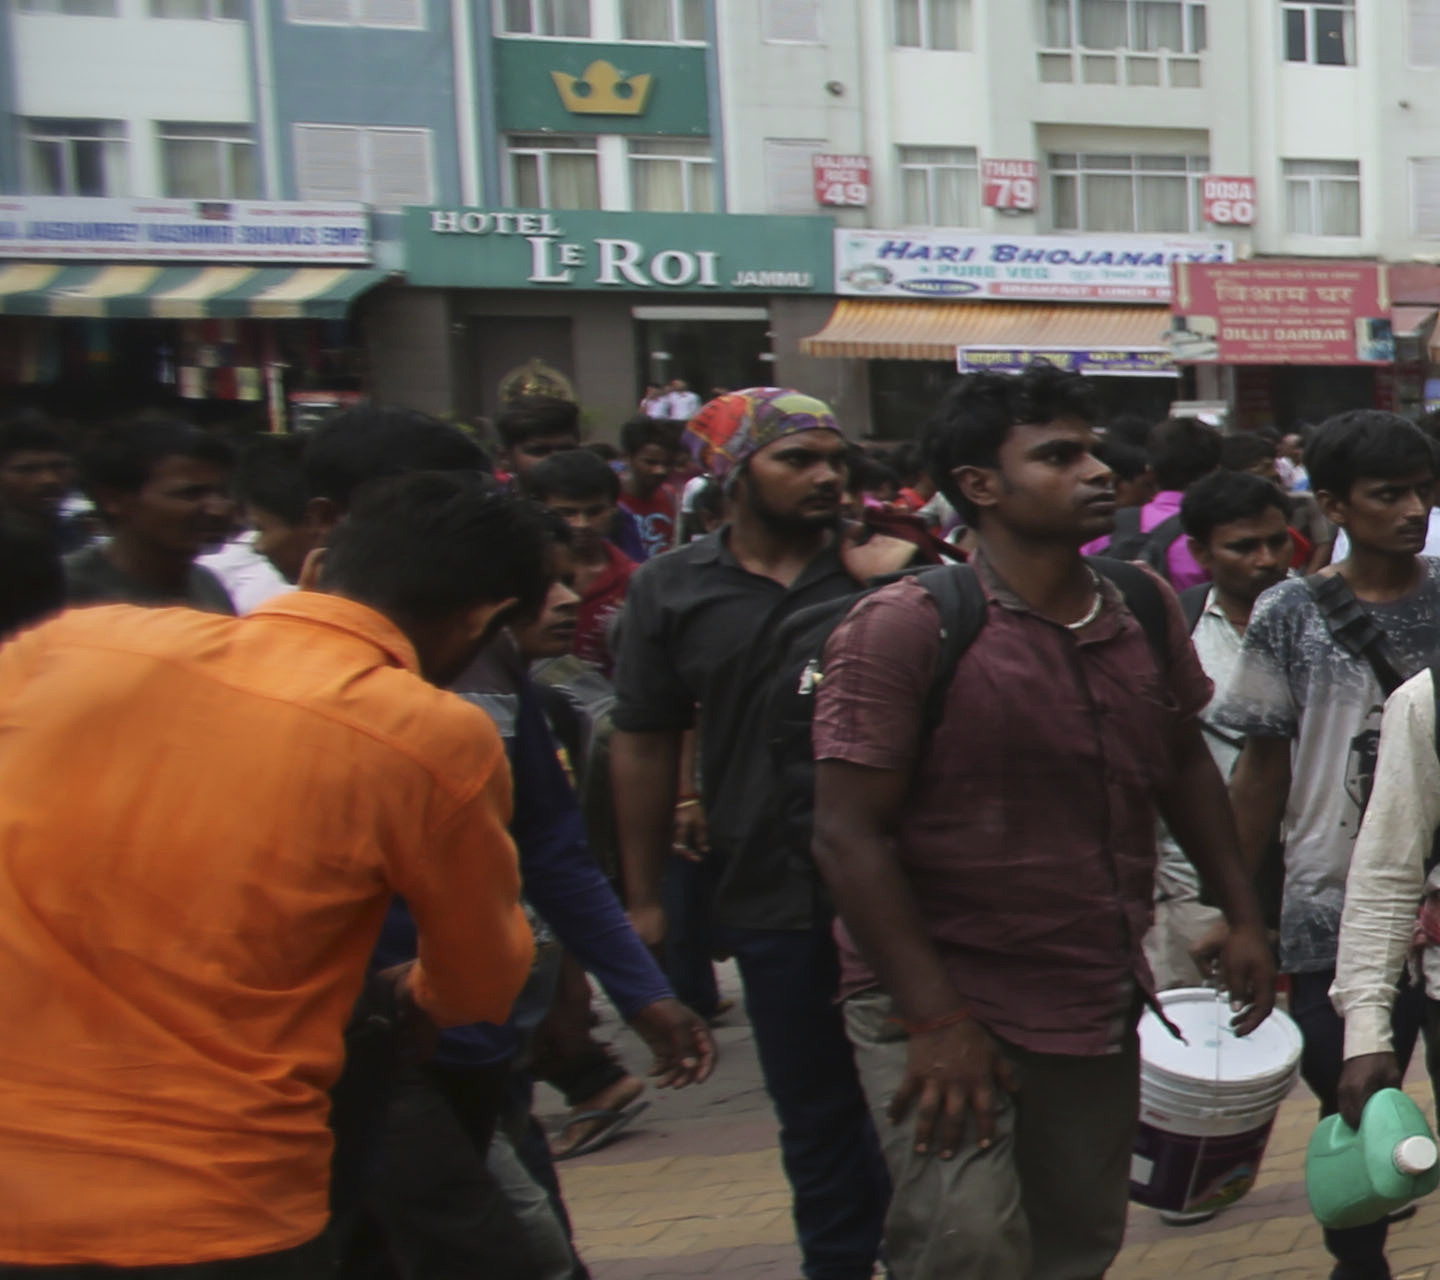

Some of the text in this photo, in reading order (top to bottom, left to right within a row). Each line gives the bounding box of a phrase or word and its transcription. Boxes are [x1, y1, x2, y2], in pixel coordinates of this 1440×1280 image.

[982, 161, 1037, 177] THALI
[824, 183, 868, 205] 49
[991, 178, 1033, 208] 79
[1204, 181, 1252, 200] DOSA
[430, 210, 562, 235] HOTEL
[1211, 200, 1253, 223] 60
[877, 240, 976, 262] HARI
[731, 270, 814, 288] JAMMU
[1274, 328, 1348, 341] DARBAR
